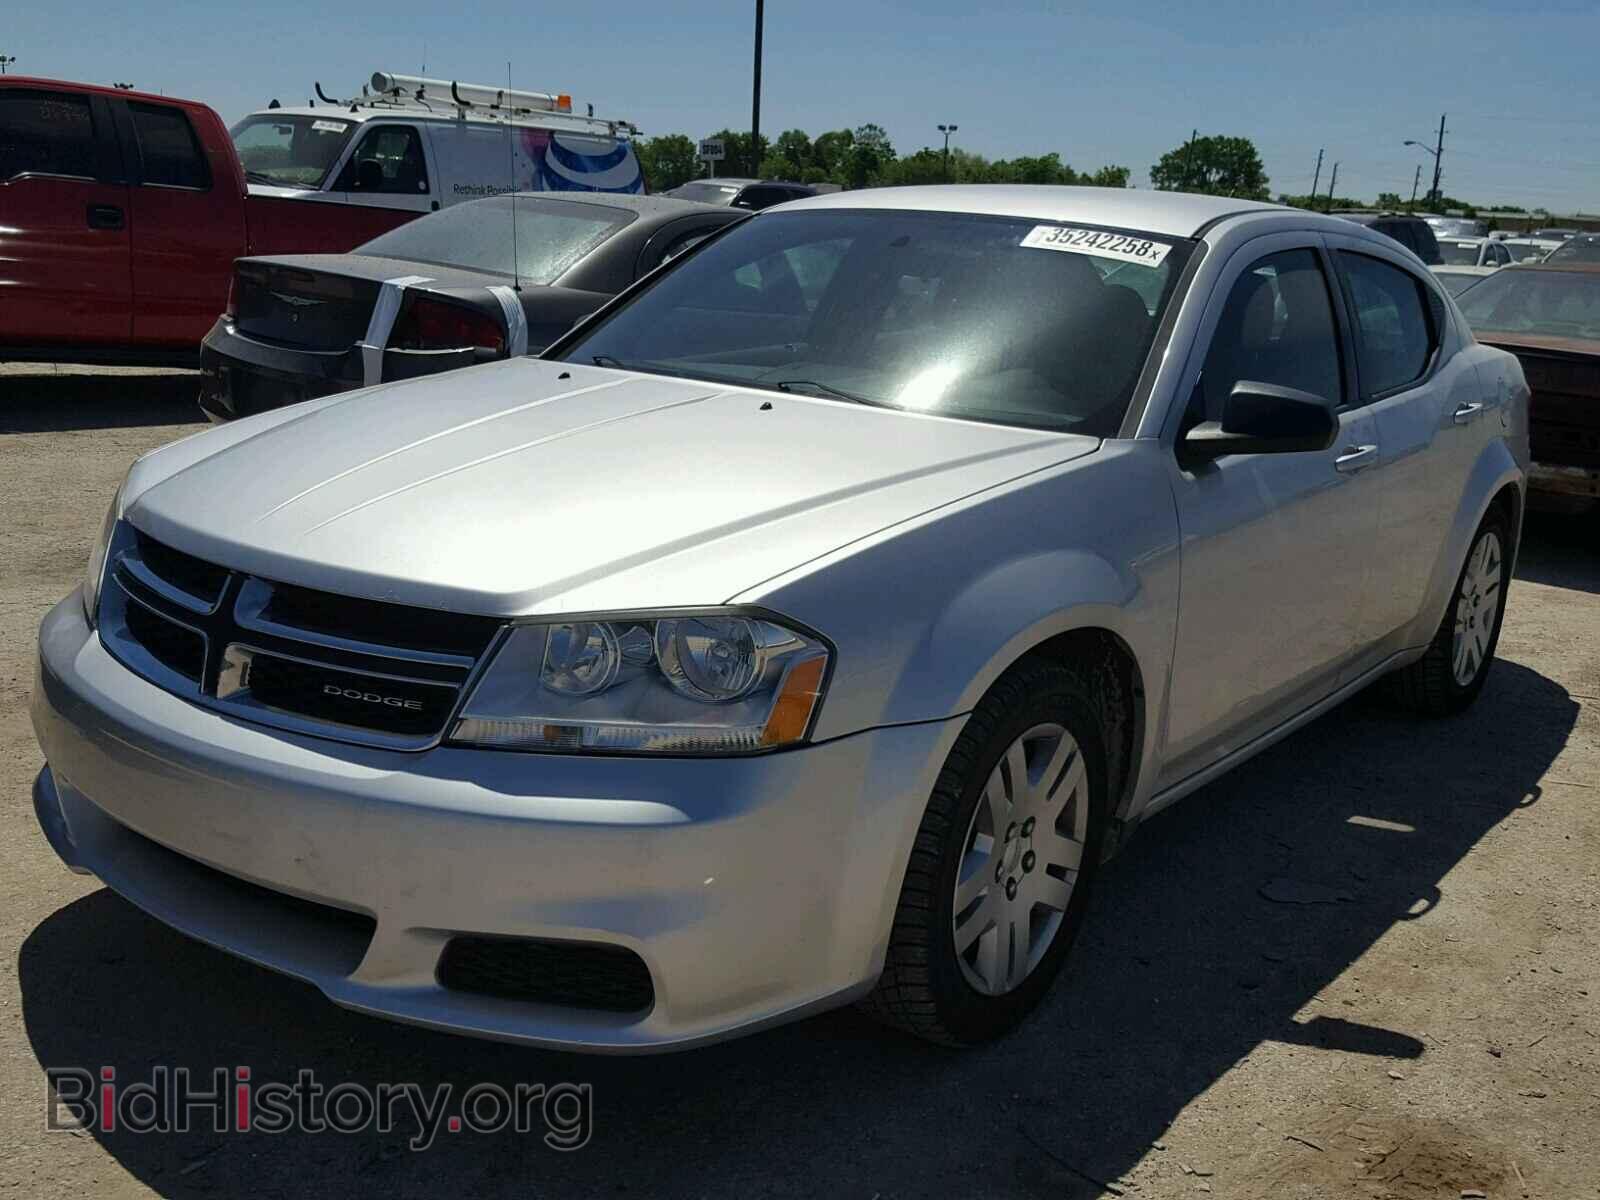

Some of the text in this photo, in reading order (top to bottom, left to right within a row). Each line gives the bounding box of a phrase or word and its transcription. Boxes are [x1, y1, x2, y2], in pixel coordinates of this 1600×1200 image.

[453, 183, 485, 195] Rethink
[1045, 228, 1153, 256] 35242258
[323, 684, 423, 710] DODGE
